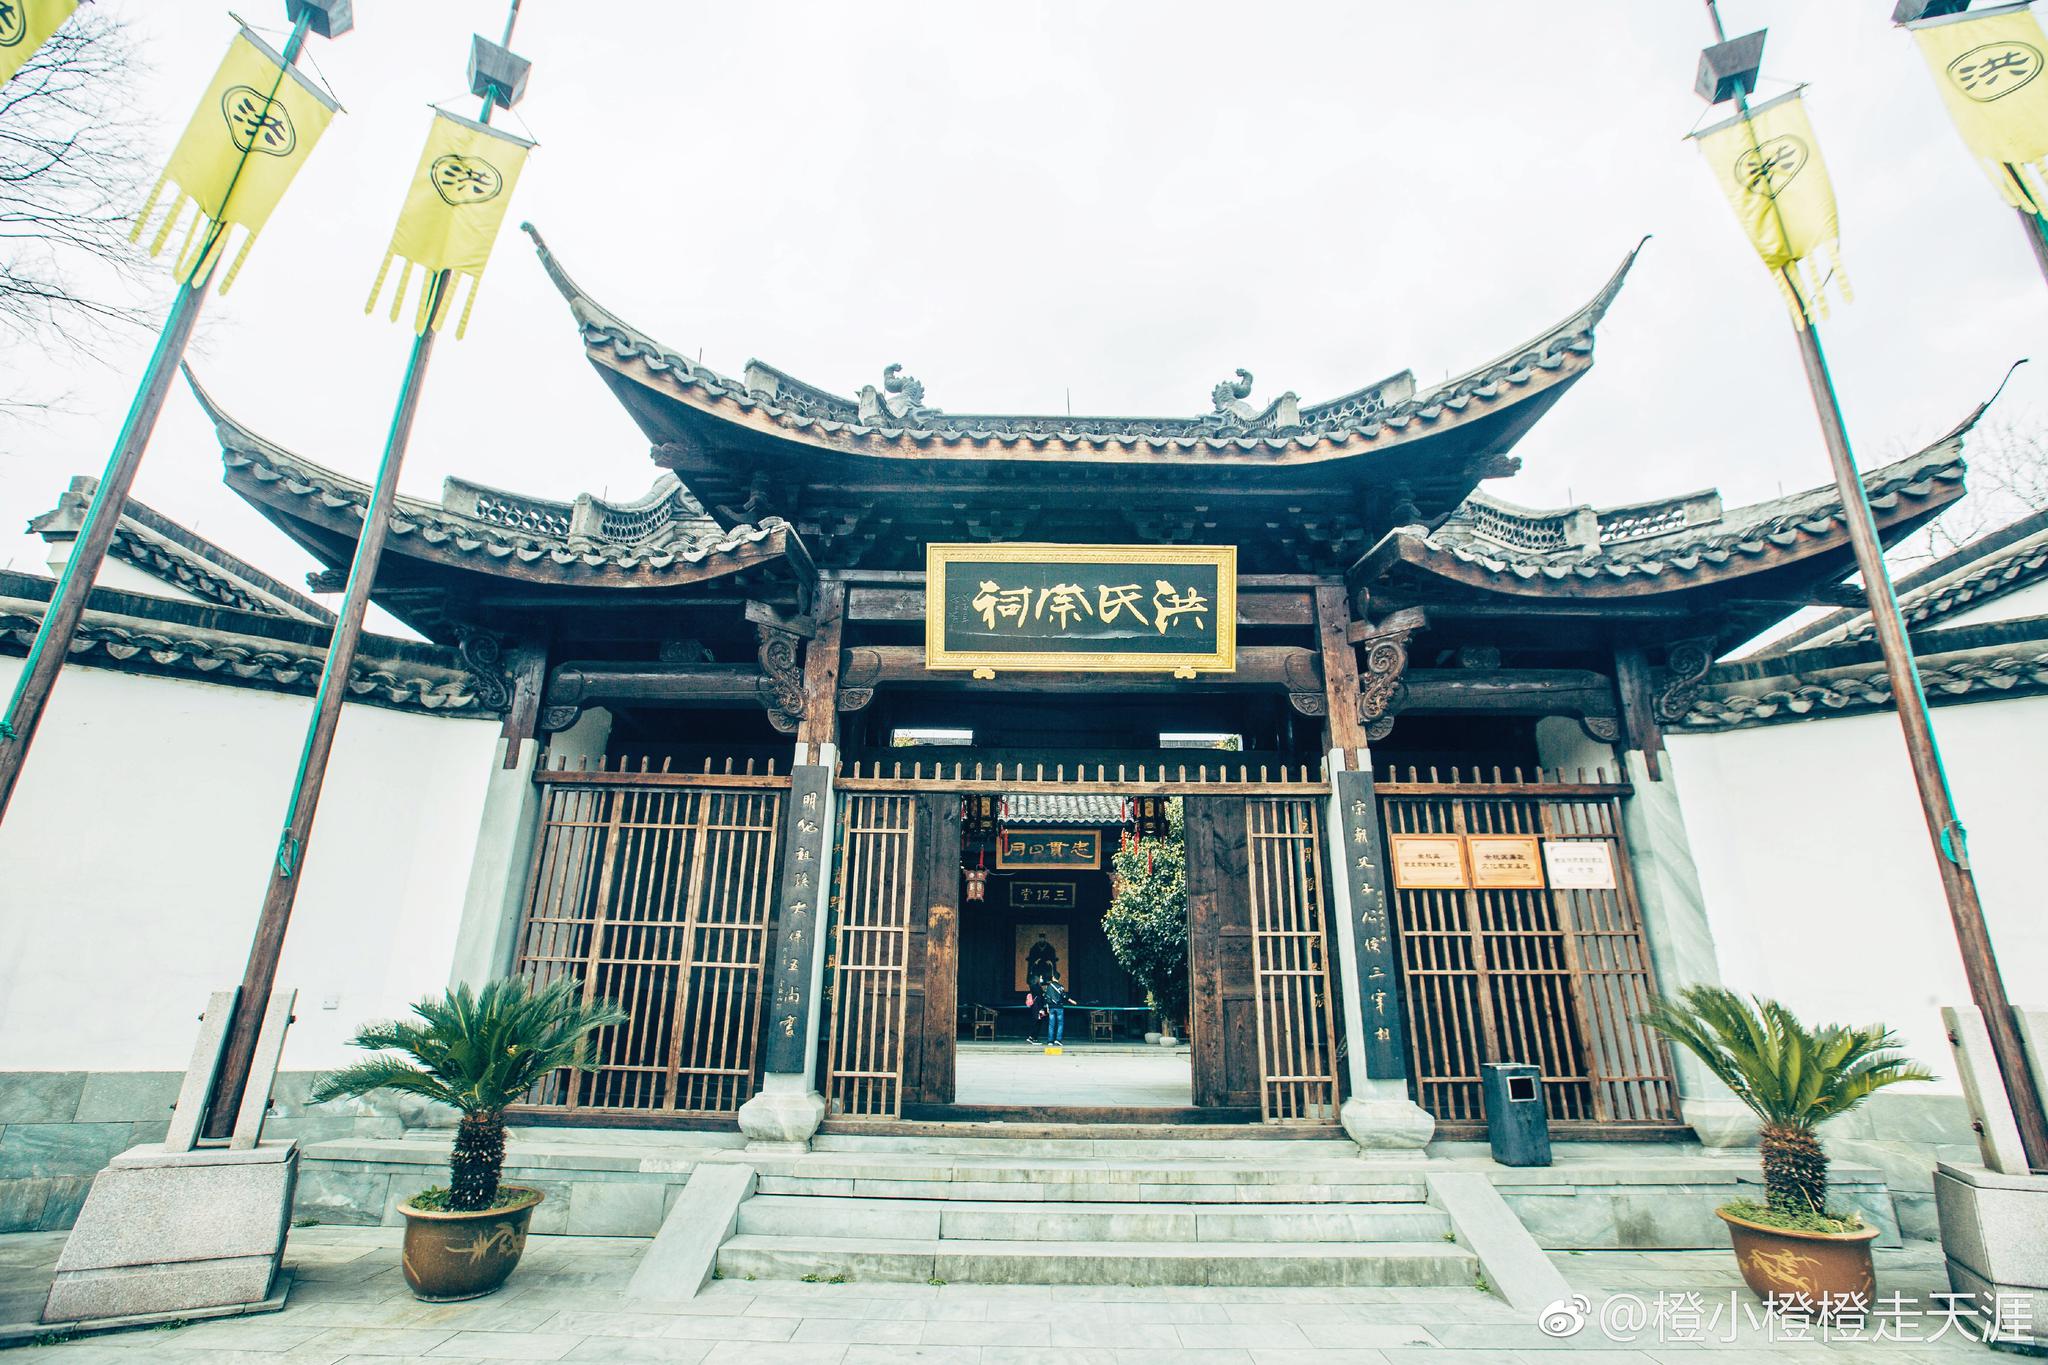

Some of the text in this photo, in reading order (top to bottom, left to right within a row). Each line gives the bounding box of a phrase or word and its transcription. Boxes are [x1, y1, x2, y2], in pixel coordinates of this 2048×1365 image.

[1959, 52, 2030, 91] 洪
[233, 97, 286, 146] 洪
[972, 579, 1209, 636] 洪氏宗祠
